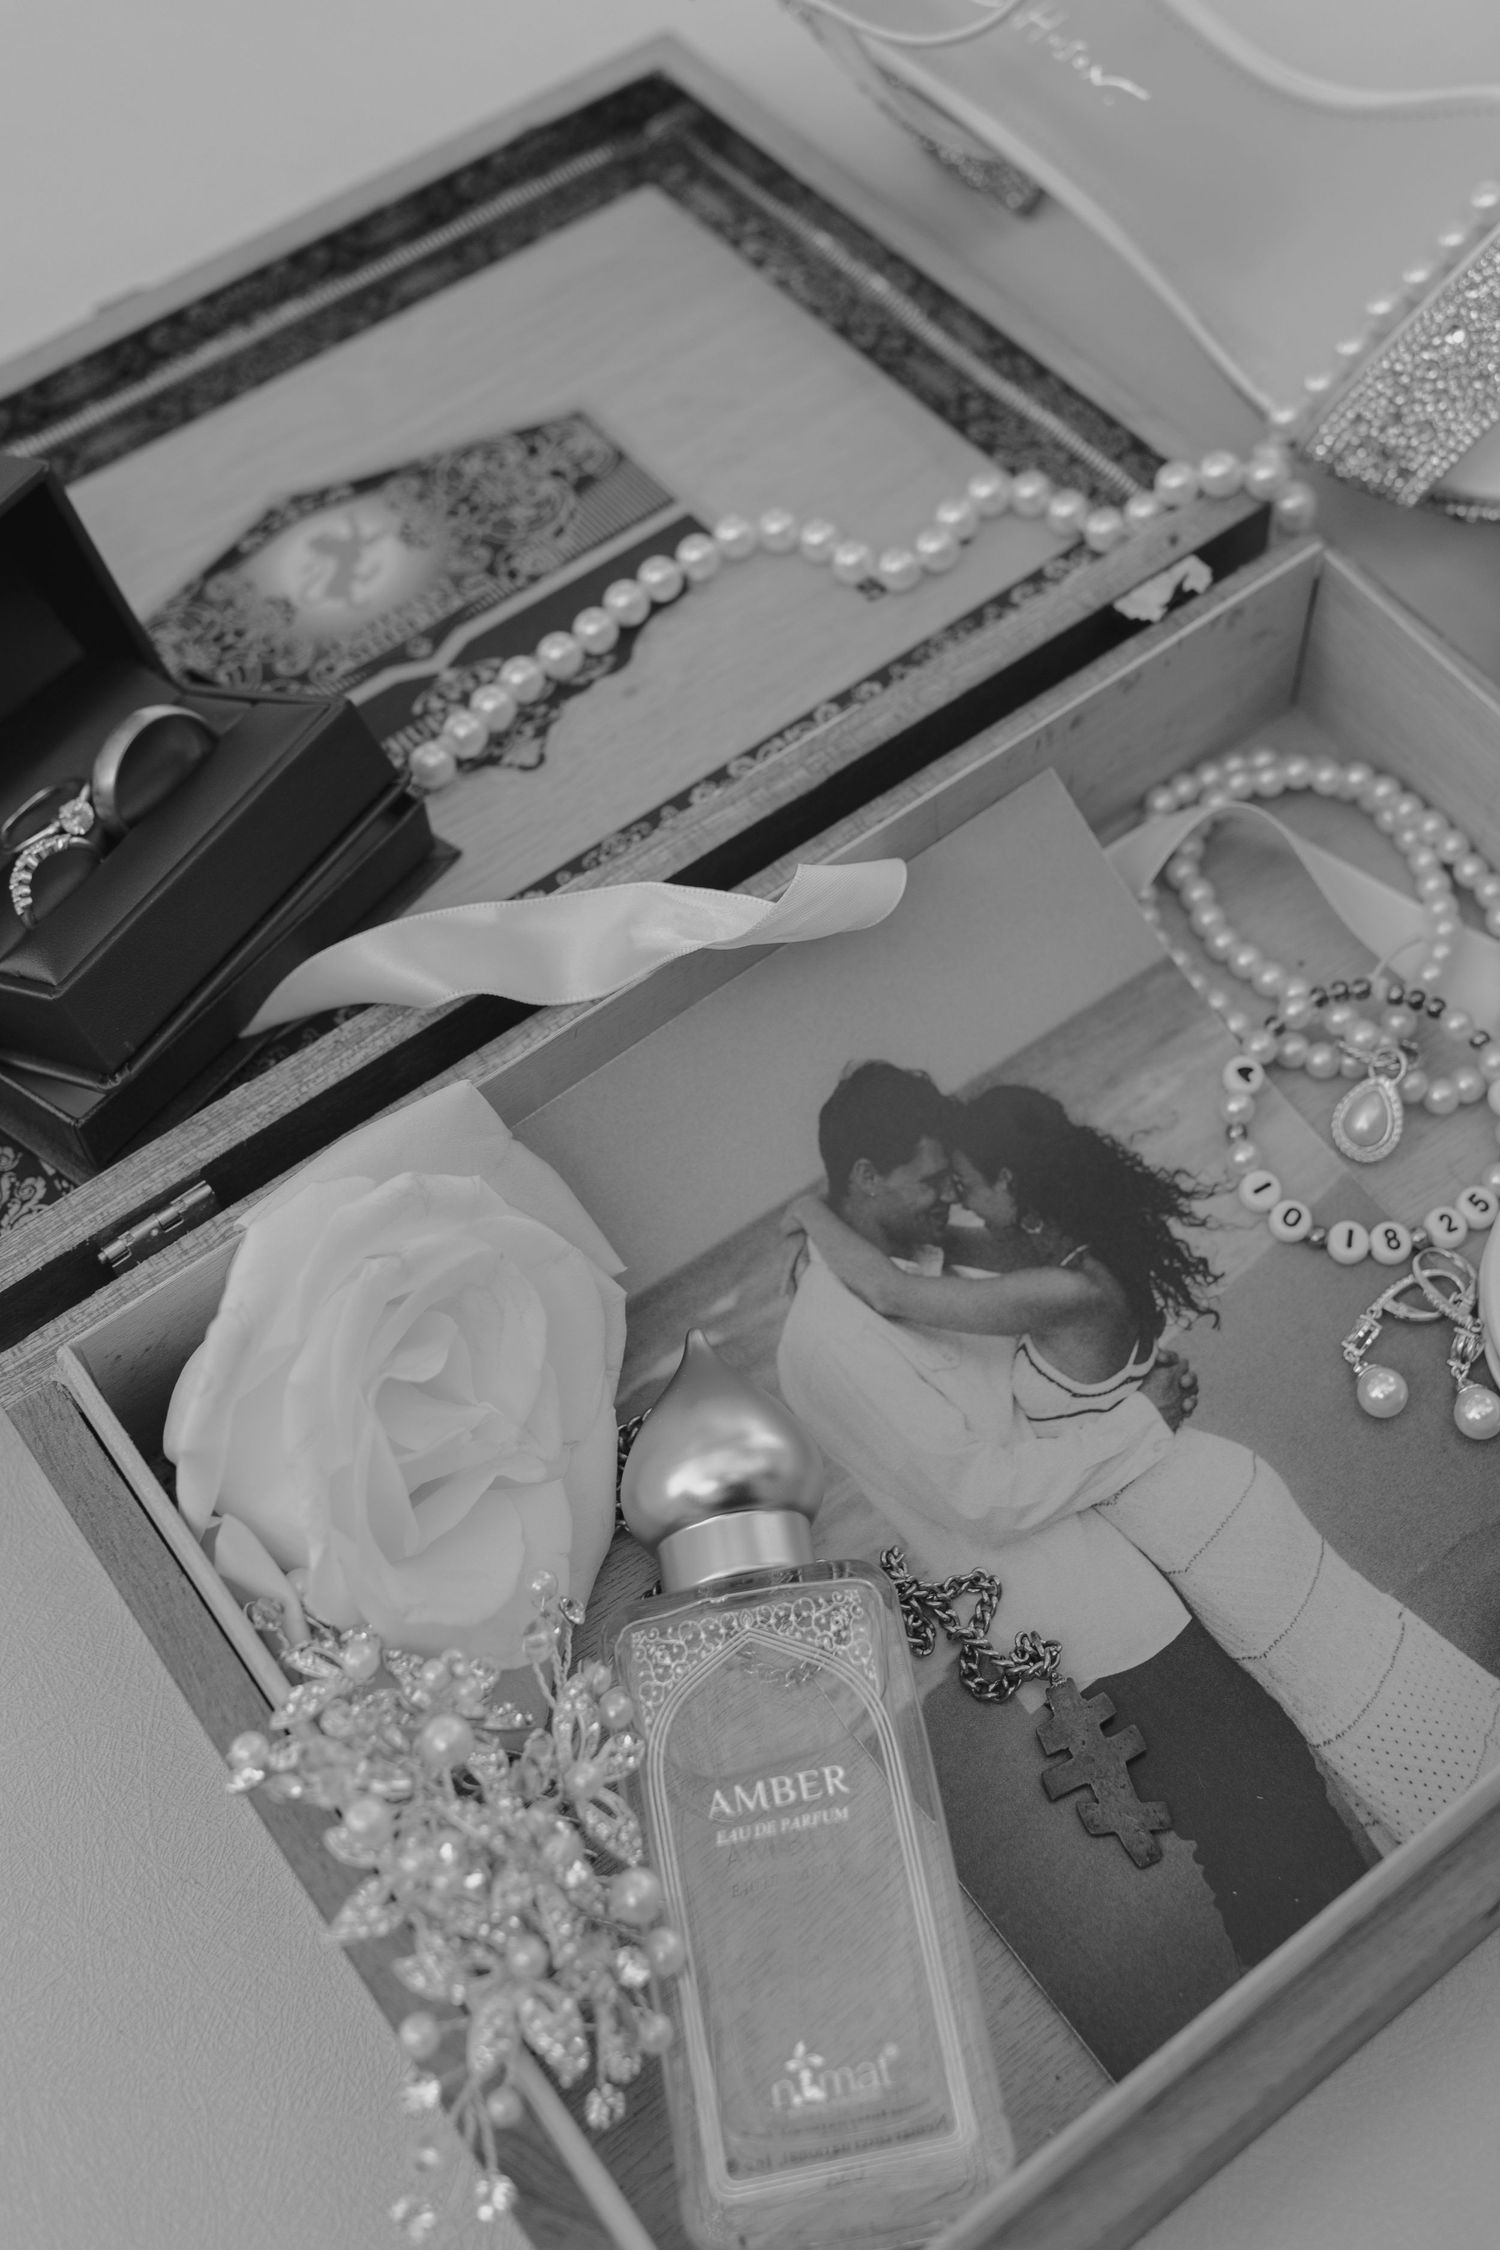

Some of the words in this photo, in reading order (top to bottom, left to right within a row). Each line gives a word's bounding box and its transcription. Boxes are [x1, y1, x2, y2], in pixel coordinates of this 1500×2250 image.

[708, 1764, 850, 1821] AMBER
[716, 1824, 750, 1847] EAU
[754, 1819, 777, 1839] DE
[781, 1806, 849, 1834] PARFUM
